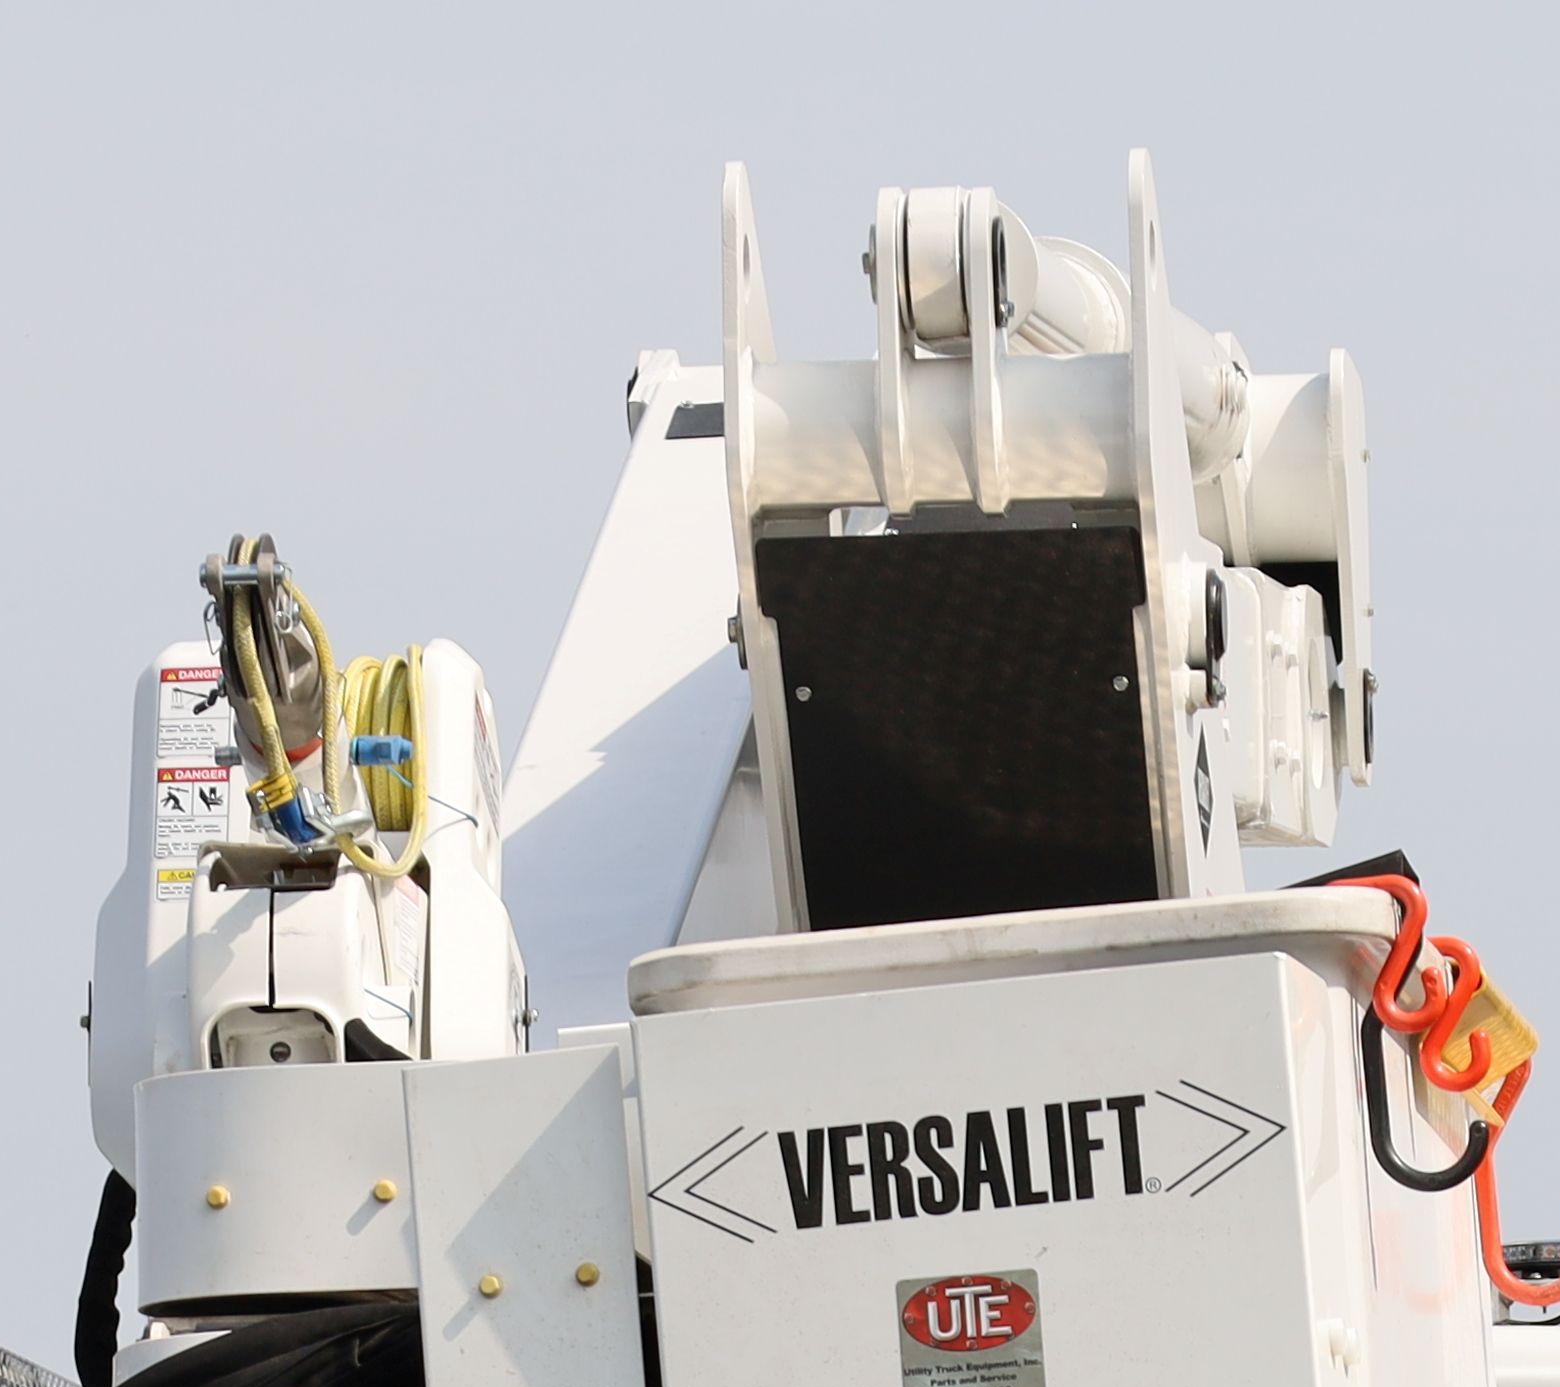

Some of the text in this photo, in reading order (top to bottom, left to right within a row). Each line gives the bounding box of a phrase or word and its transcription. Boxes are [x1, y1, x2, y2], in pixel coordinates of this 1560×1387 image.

[178, 669, 222, 680] DANGE
[175, 769, 227, 780] DANGER
[927, 1284, 1013, 1341] UTE
[903, 1367, 933, 1377] Utility
[936, 1364, 964, 1373] Truck
[930, 1373, 1017, 1387] Parts and Service
